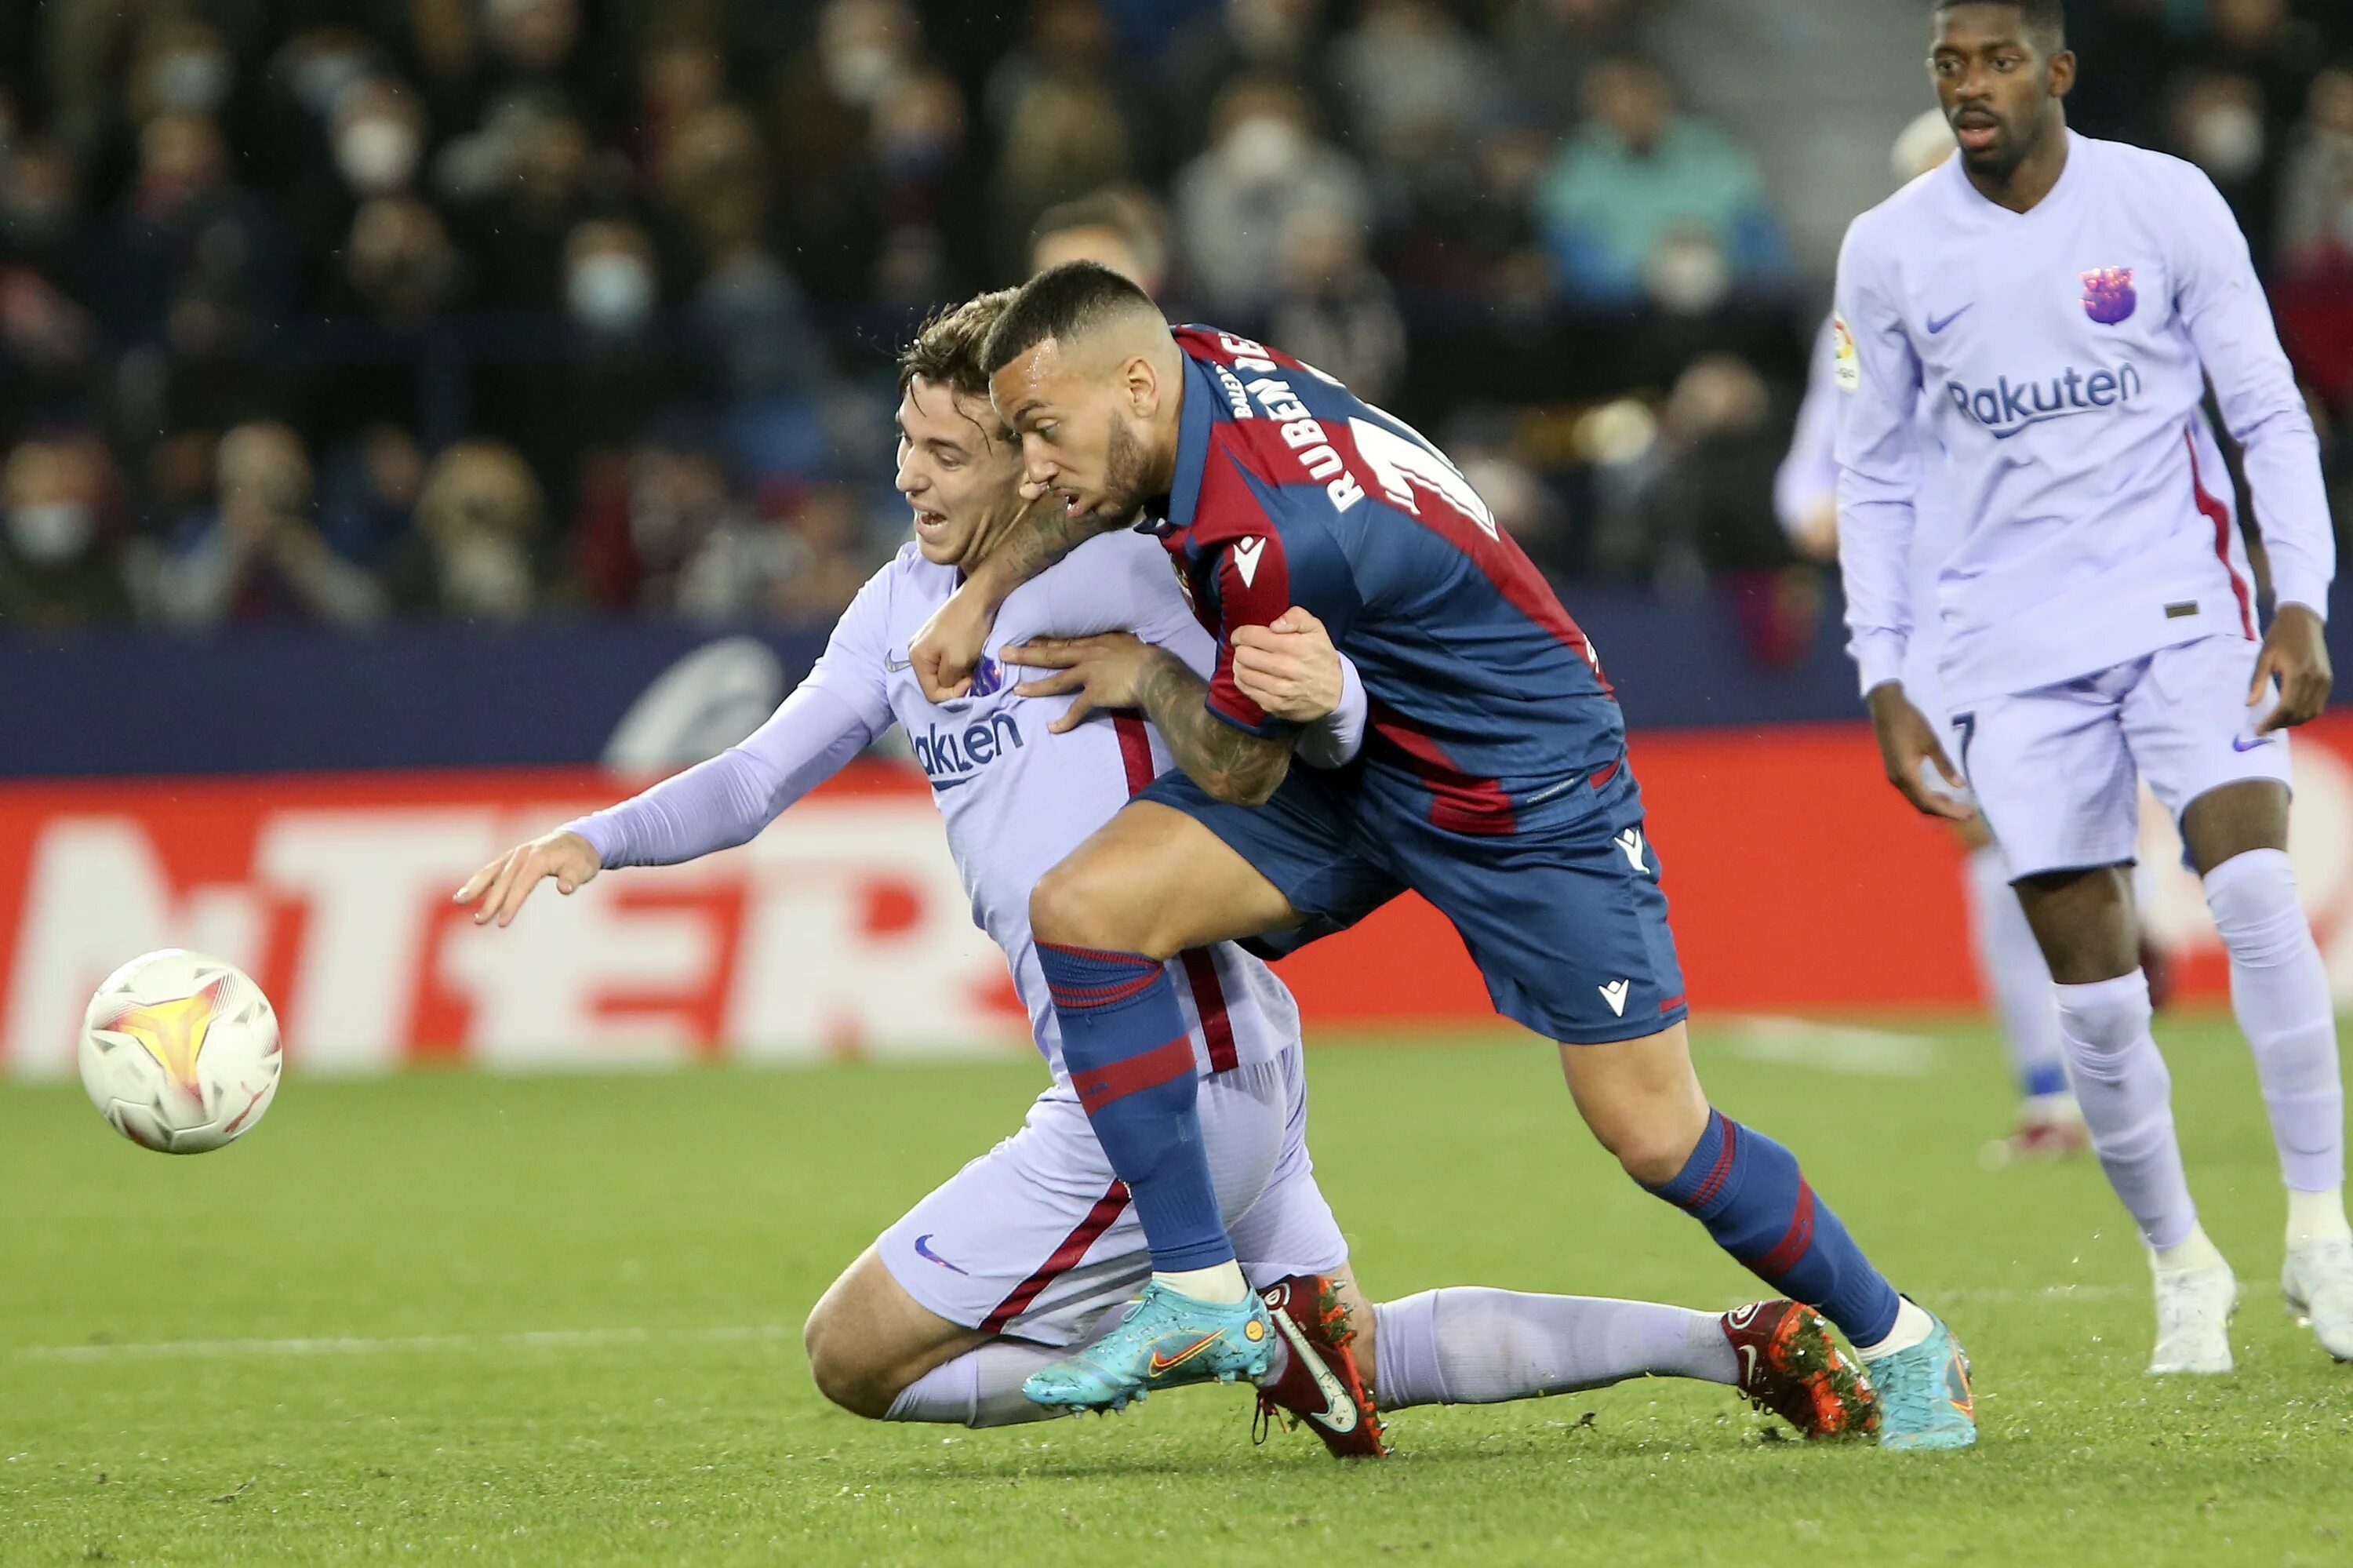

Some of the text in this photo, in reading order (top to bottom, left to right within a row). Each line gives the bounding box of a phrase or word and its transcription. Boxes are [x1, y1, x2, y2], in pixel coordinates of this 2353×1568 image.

[1218, 331, 1366, 513] RUBEN VE
[1946, 362, 2141, 426] Rakuten
[1952, 711, 1975, 787] 7
